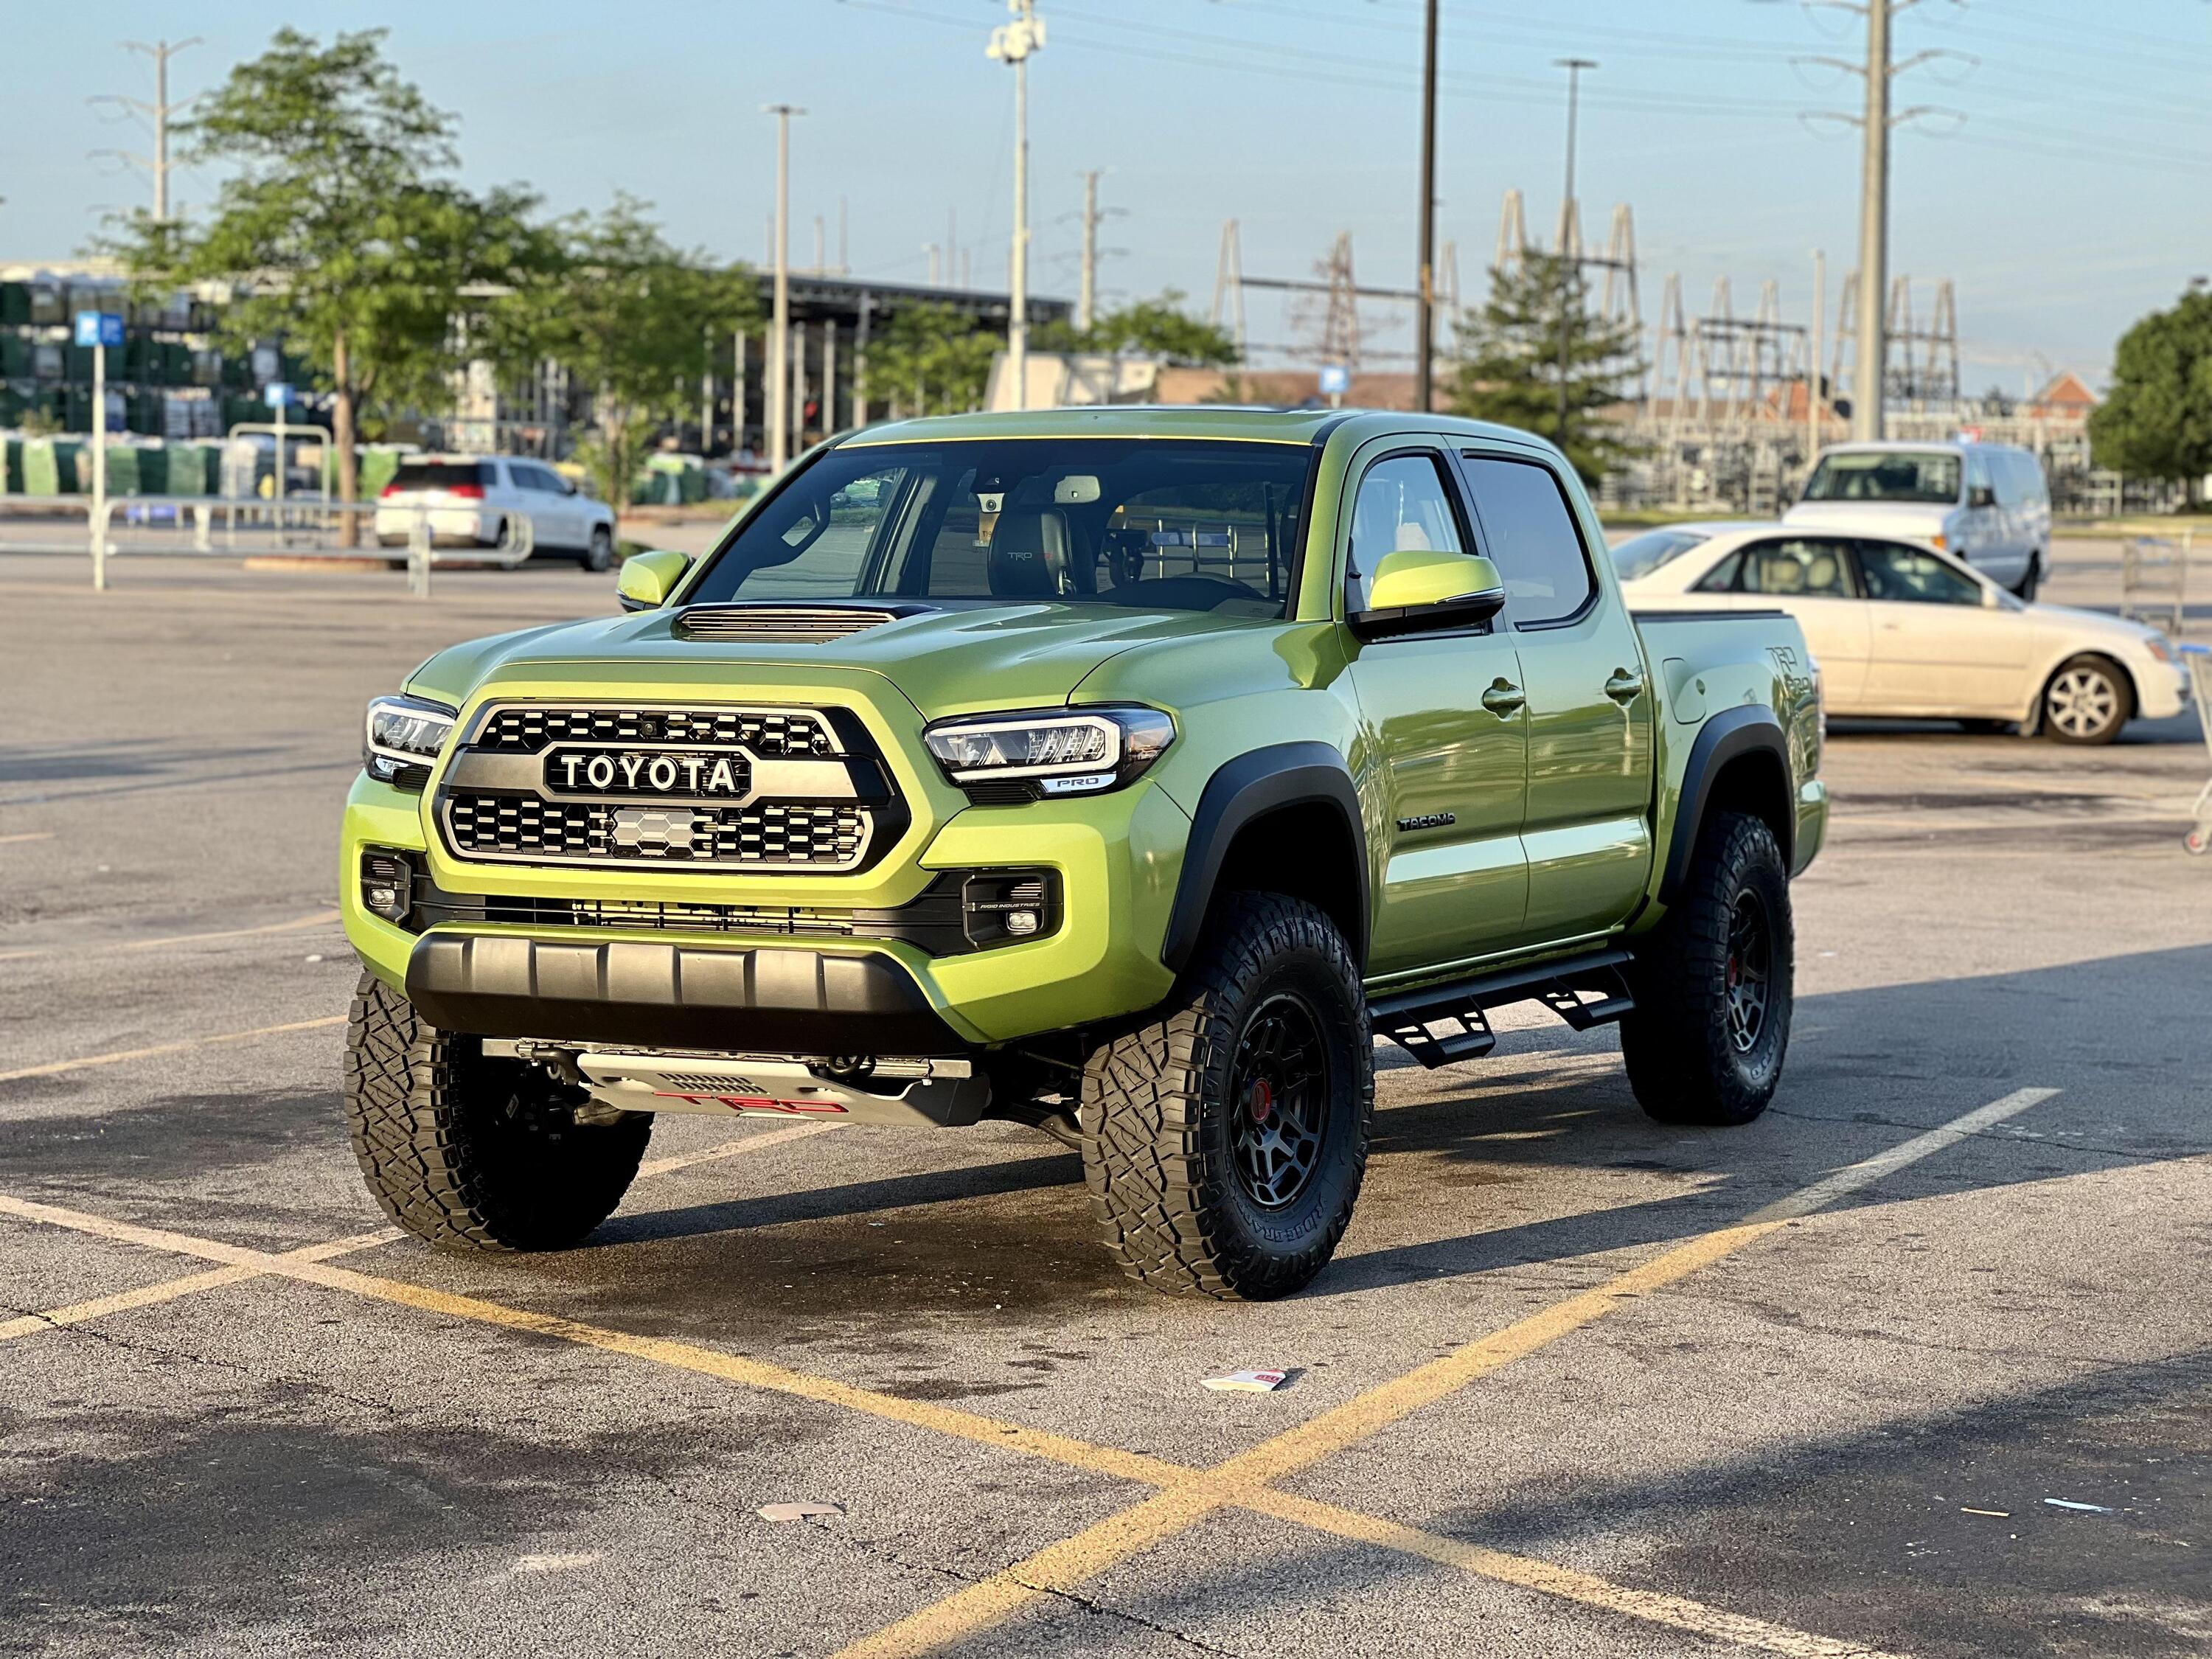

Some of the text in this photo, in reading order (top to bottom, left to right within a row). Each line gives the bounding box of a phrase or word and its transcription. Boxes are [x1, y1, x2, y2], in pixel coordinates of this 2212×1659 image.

[1007, 552, 1032, 560] TRD
[560, 754, 740, 793] TOYOTA
[1057, 777, 1099, 787] PRO
[1397, 813, 1455, 832] TACOMA
[652, 1091, 849, 1114] TRD
